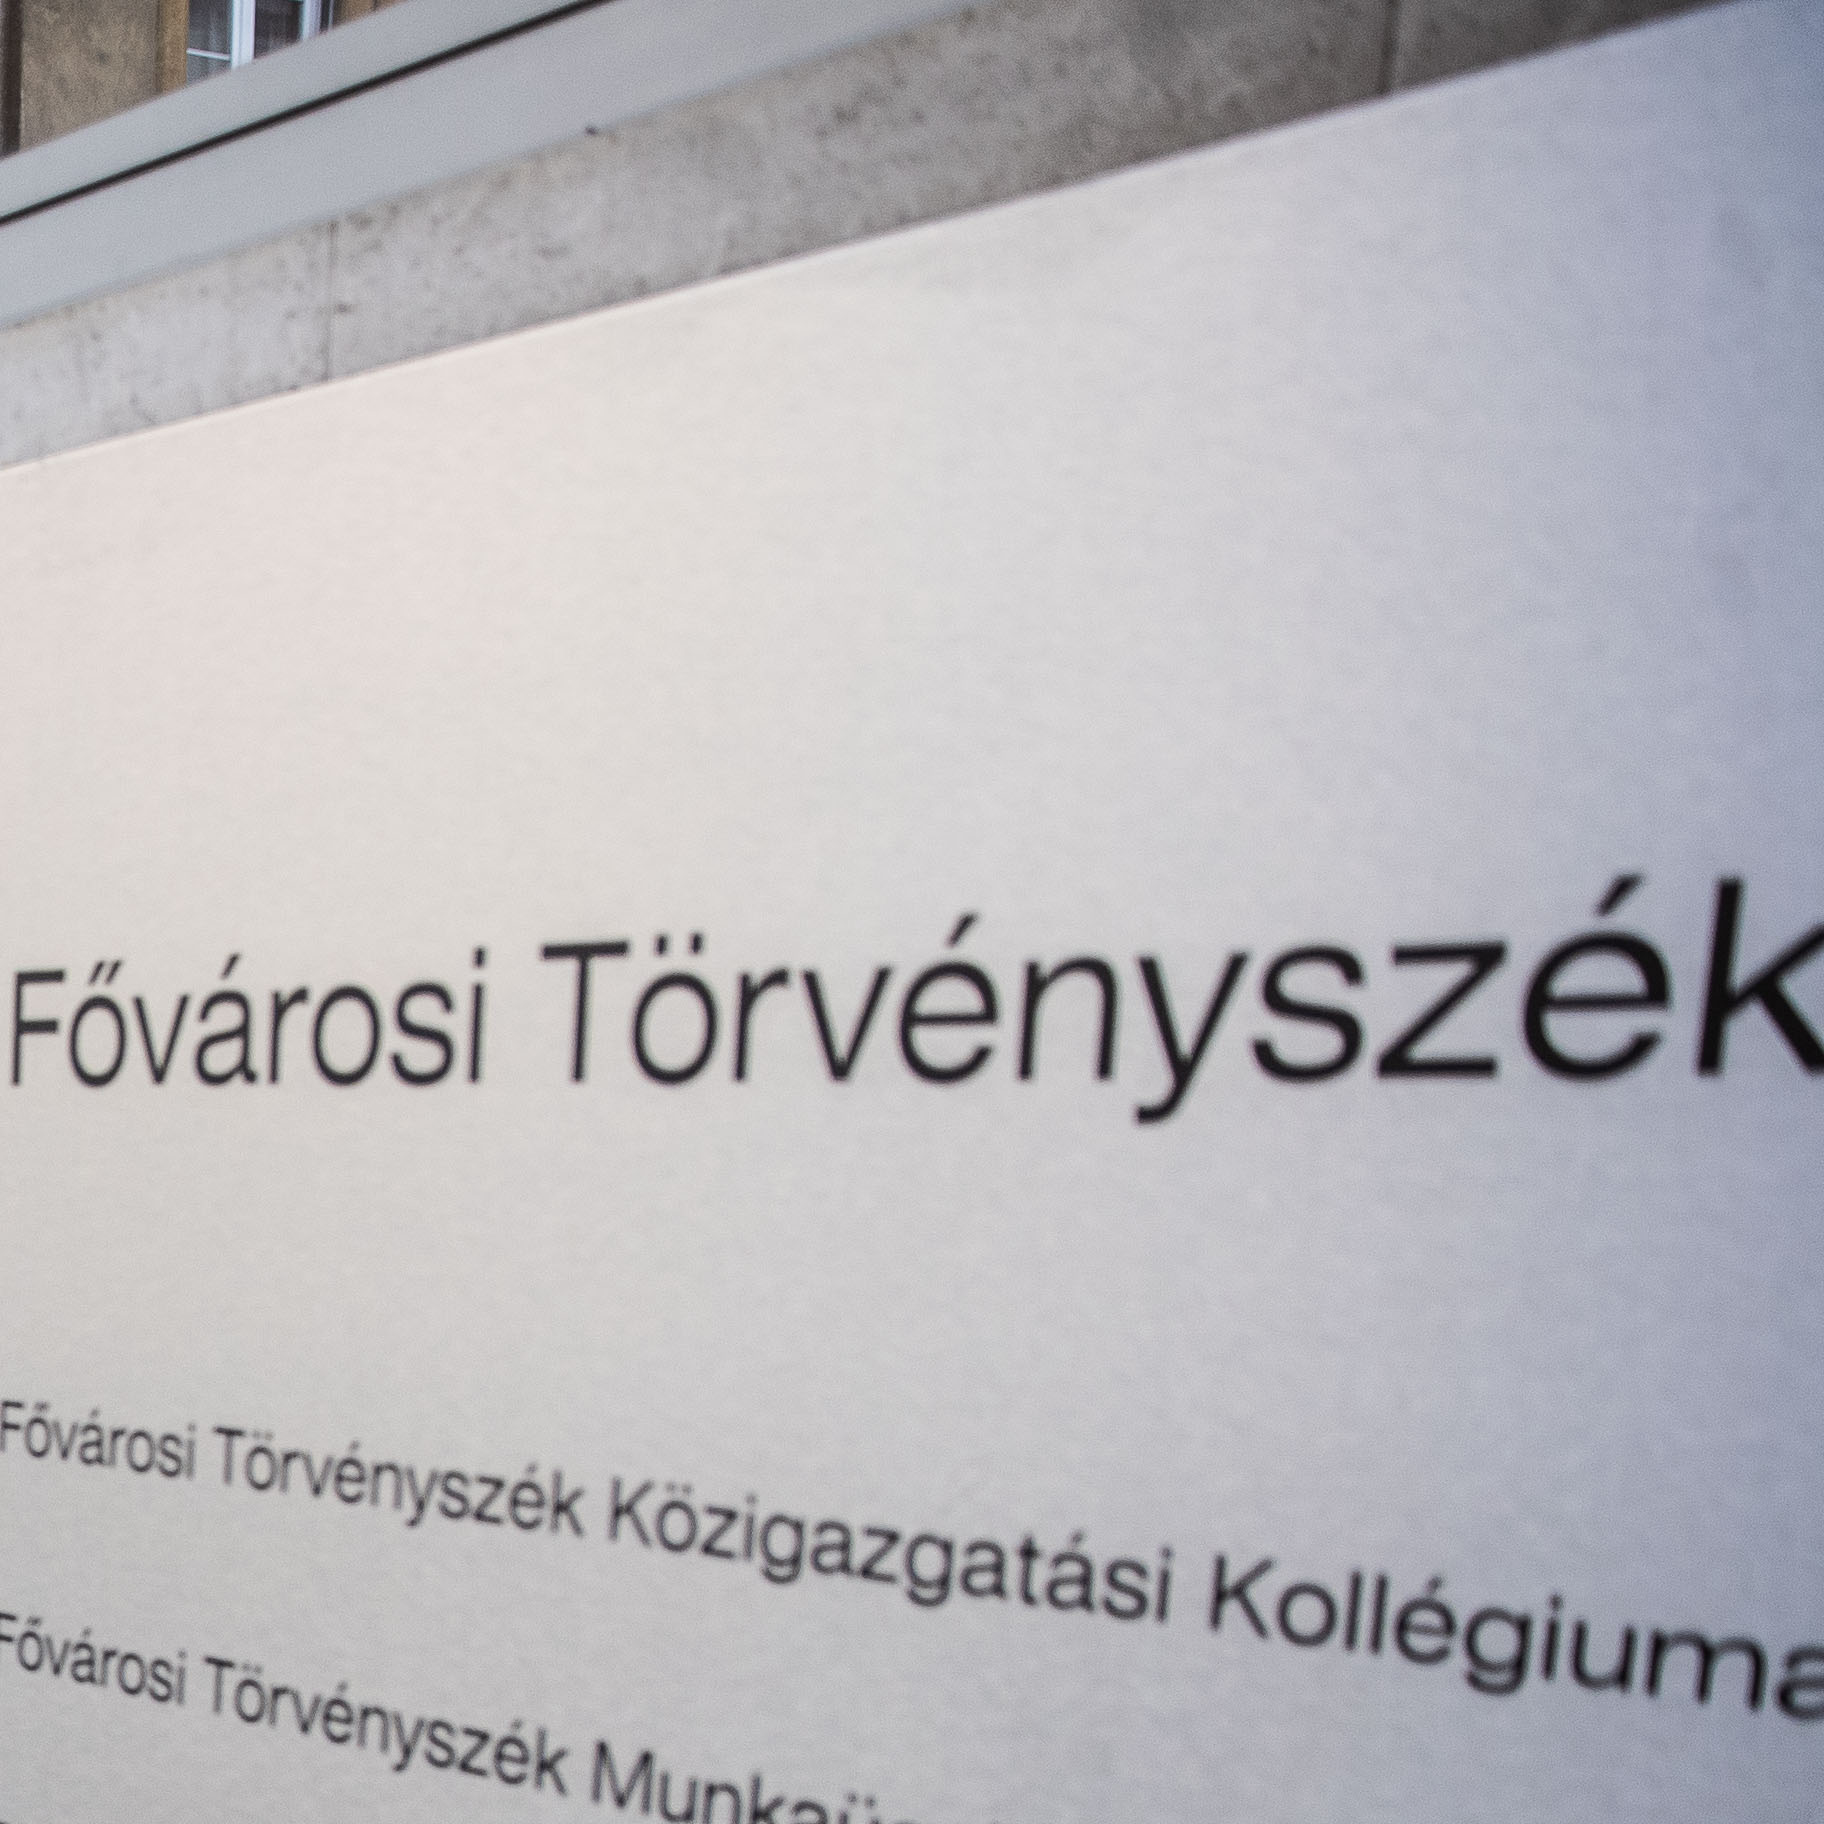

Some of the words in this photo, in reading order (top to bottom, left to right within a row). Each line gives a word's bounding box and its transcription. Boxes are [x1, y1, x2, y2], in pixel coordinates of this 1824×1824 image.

[10, 945, 489, 1090] Fővárosi
[538, 871, 1824, 1128] Törvényszék
[212, 1425, 585, 1538] Törvényszék
[608, 1477, 1174, 1625] Közigazgatási
[1207, 1552, 1824, 1724] Kollégiuma
[202, 1655, 569, 1797] Törvényszék
